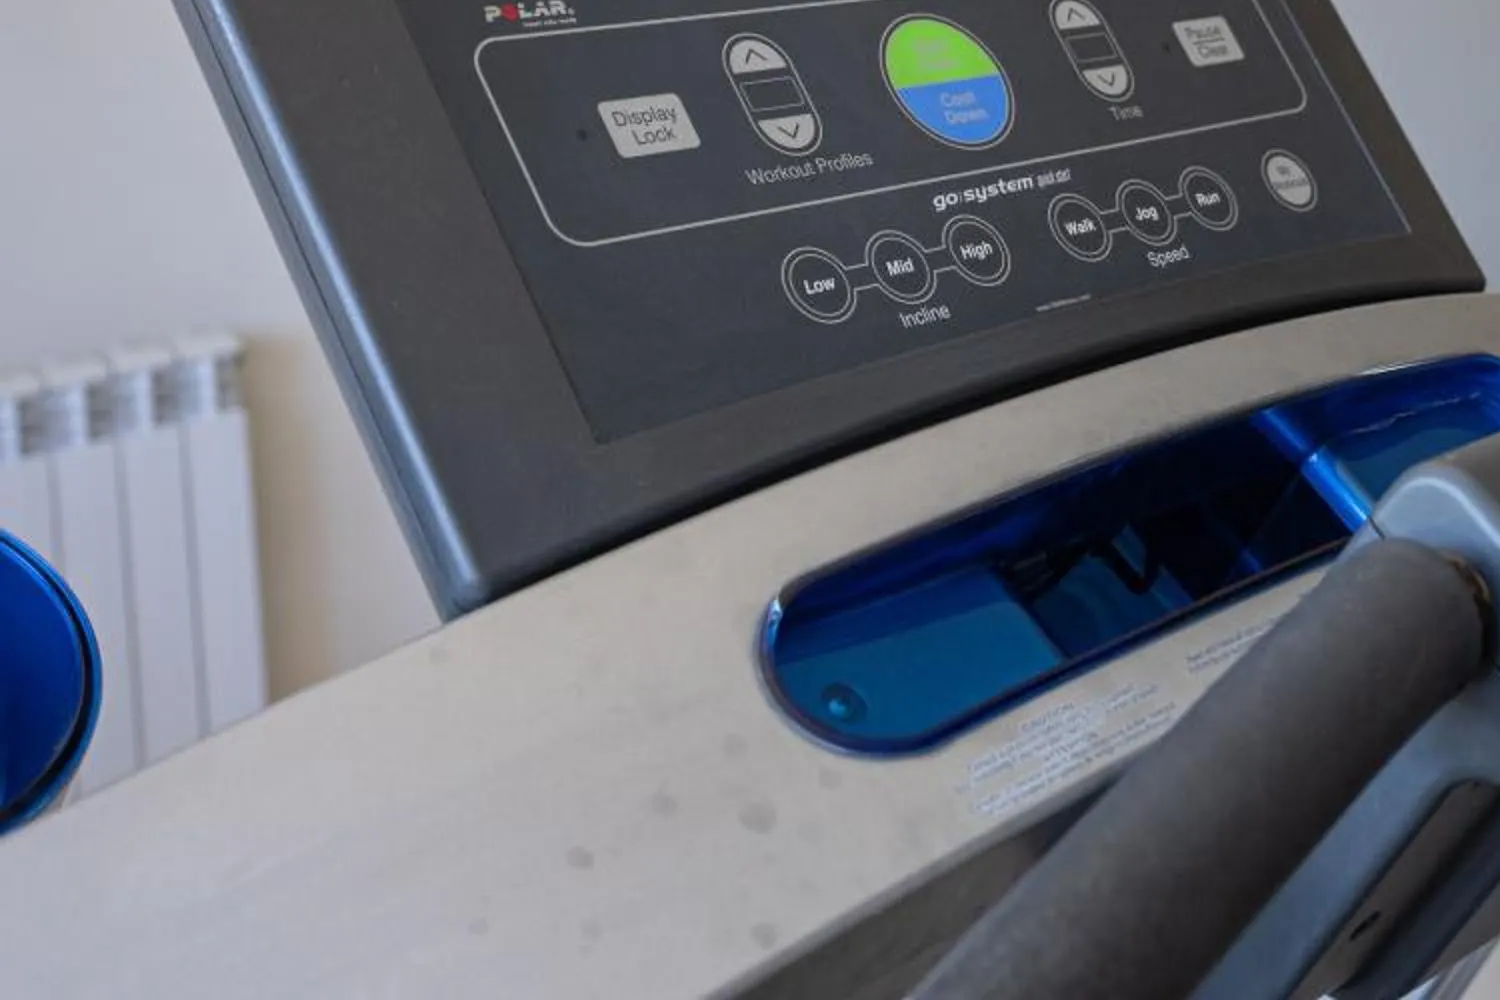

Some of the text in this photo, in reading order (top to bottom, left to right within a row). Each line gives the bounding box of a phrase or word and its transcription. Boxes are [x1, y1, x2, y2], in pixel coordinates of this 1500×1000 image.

[611, 105, 678, 127] Display
[1108, 104, 1143, 121] Time
[632, 127, 677, 146] Lock
[744, 152, 874, 186] Workout Profiles
[1194, 192, 1221, 208] Run
[1135, 205, 1159, 222] Jog
[1064, 217, 1097, 236] Walk
[959, 240, 994, 260] High
[1146, 243, 1192, 269] Speed
[885, 256, 915, 277] Mid
[803, 276, 836, 296] Low
[899, 303, 951, 329] Incline
